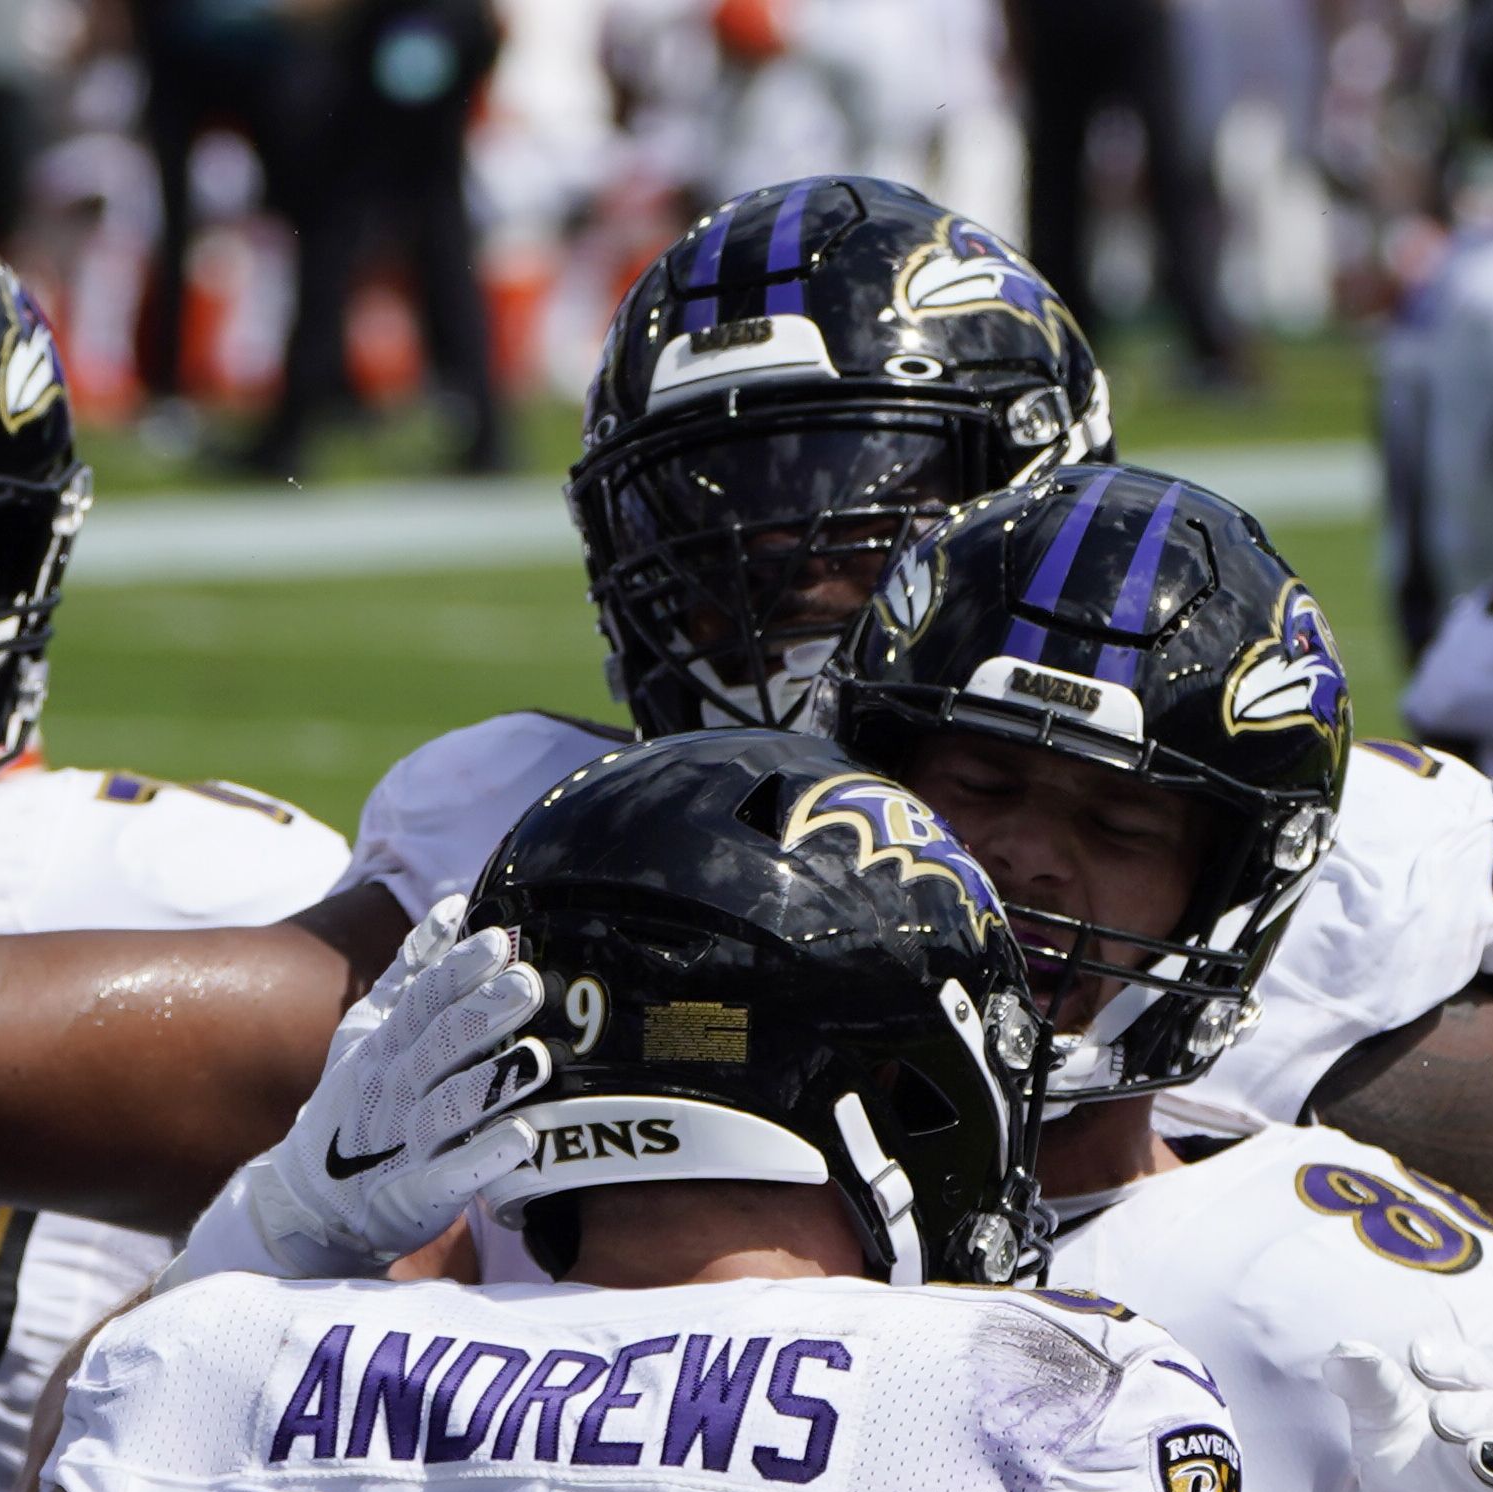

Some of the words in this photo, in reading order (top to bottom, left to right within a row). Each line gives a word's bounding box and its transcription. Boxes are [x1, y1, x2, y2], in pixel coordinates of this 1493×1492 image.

[1010, 667, 1102, 713] RAVENS
[513, 1118, 681, 1173] VENS
[268, 1324, 852, 1485] ANDREWS
[1165, 1433, 1240, 1471] RAVENS
